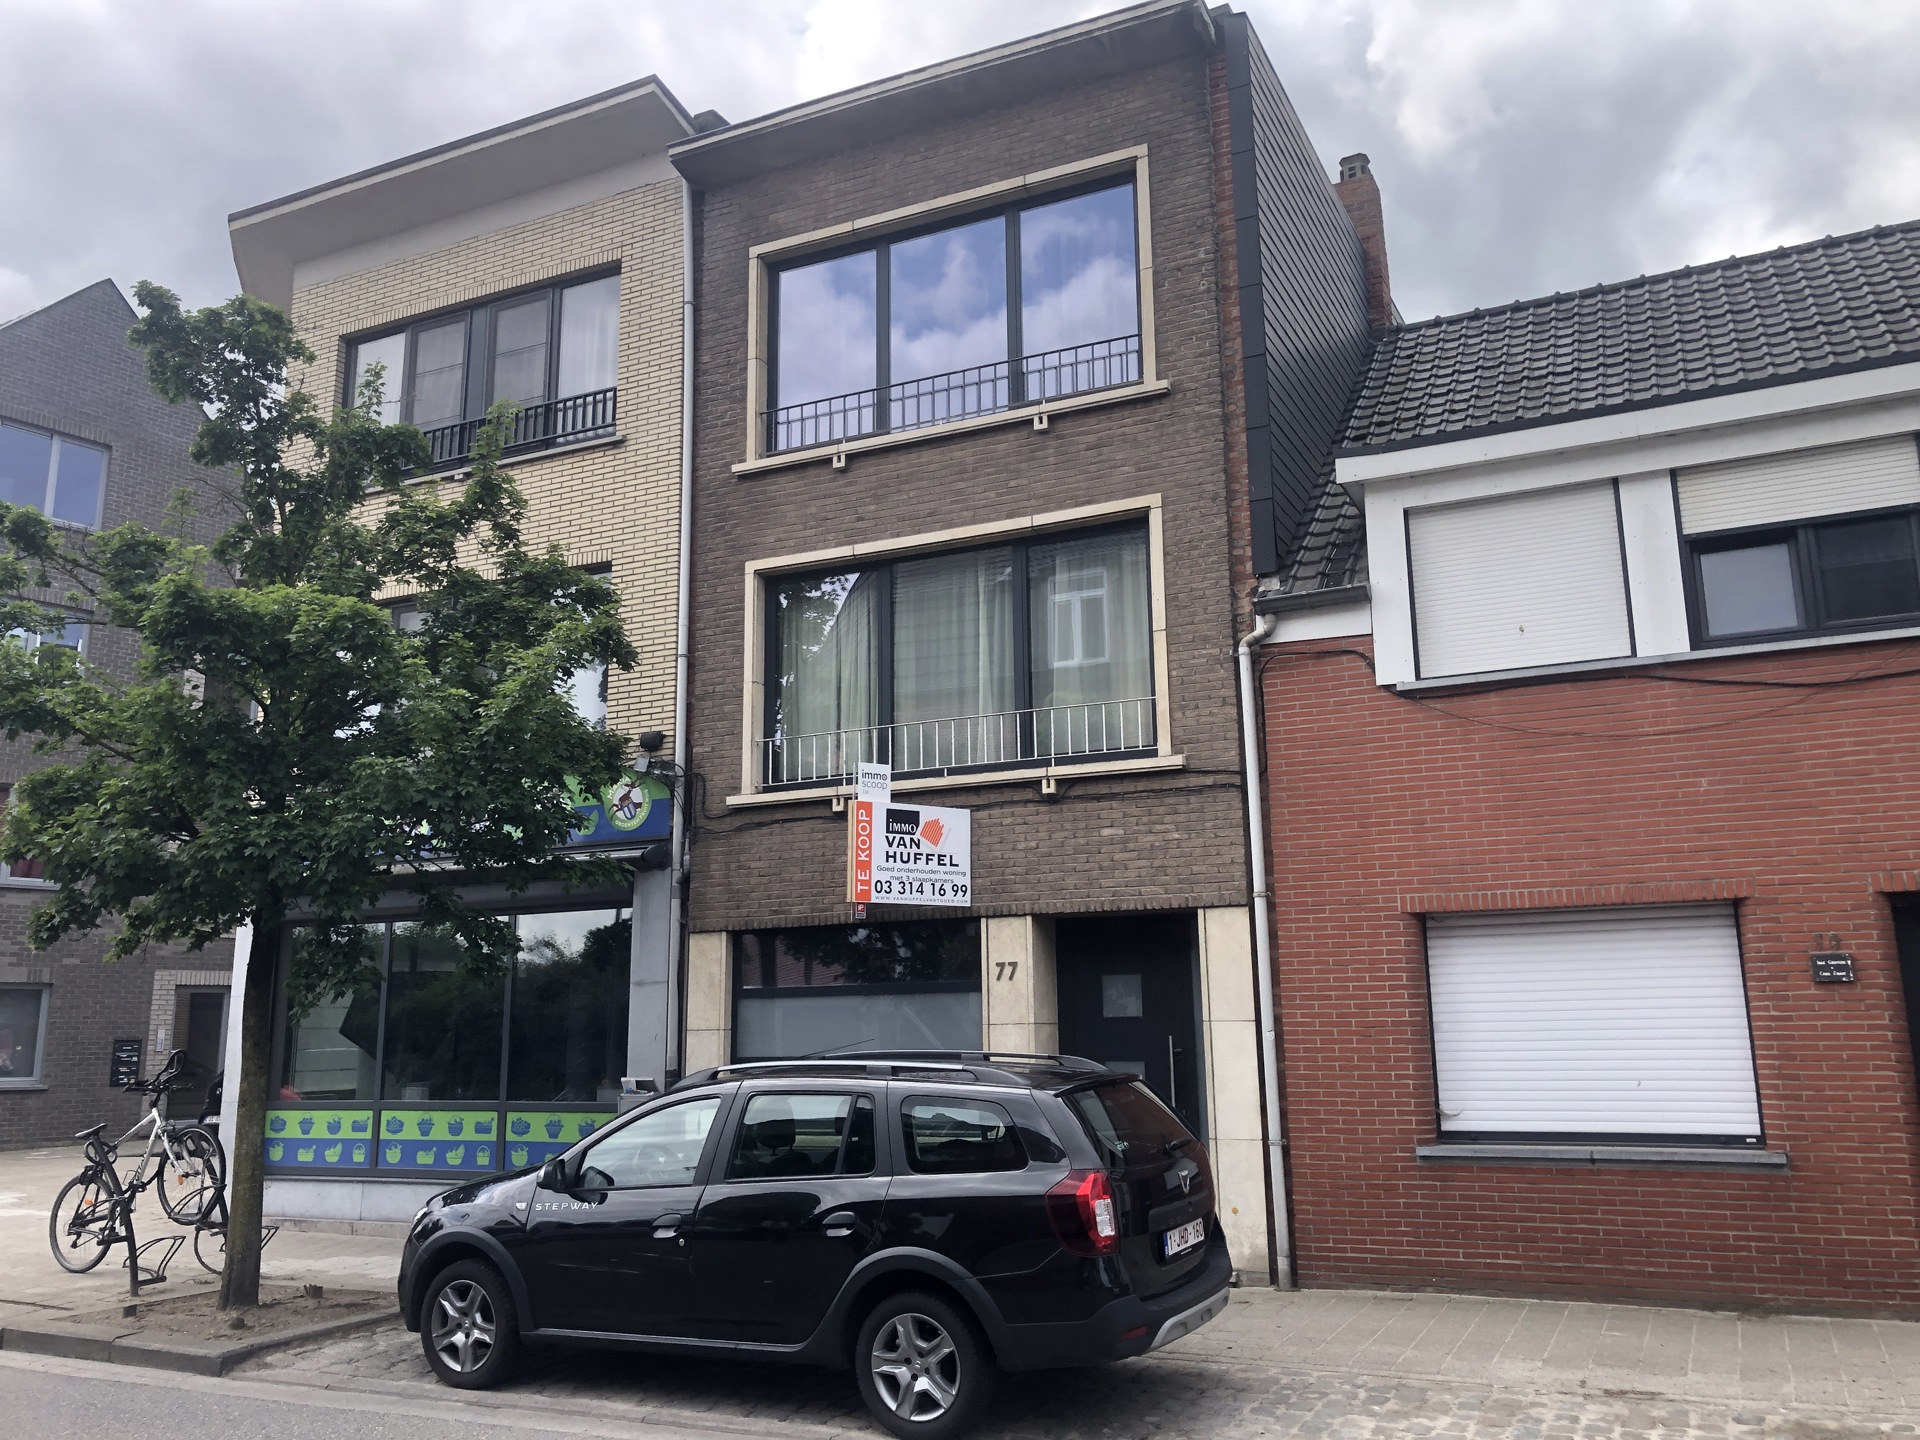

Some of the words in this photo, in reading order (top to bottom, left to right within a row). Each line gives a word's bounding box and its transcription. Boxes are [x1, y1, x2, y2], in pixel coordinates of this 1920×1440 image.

[862, 769, 887, 781] immo
[862, 781, 887, 791] scoop
[858, 809, 871, 861] KOOP
[885, 835, 921, 850] VAN
[885, 850, 960, 868] HUFFEL
[876, 865, 895, 873] Goed
[897, 867, 942, 875] onderhouden
[857, 869, 870, 894] TE
[912, 876, 955, 884] slaapkamers
[874, 880, 892, 895] 03
[897, 881, 925, 896] 314
[931, 883, 947, 897] 16
[951, 884, 968, 898] 99
[995, 961, 1018, 982] 77
[535, 1202, 599, 1211] STEPWAY
